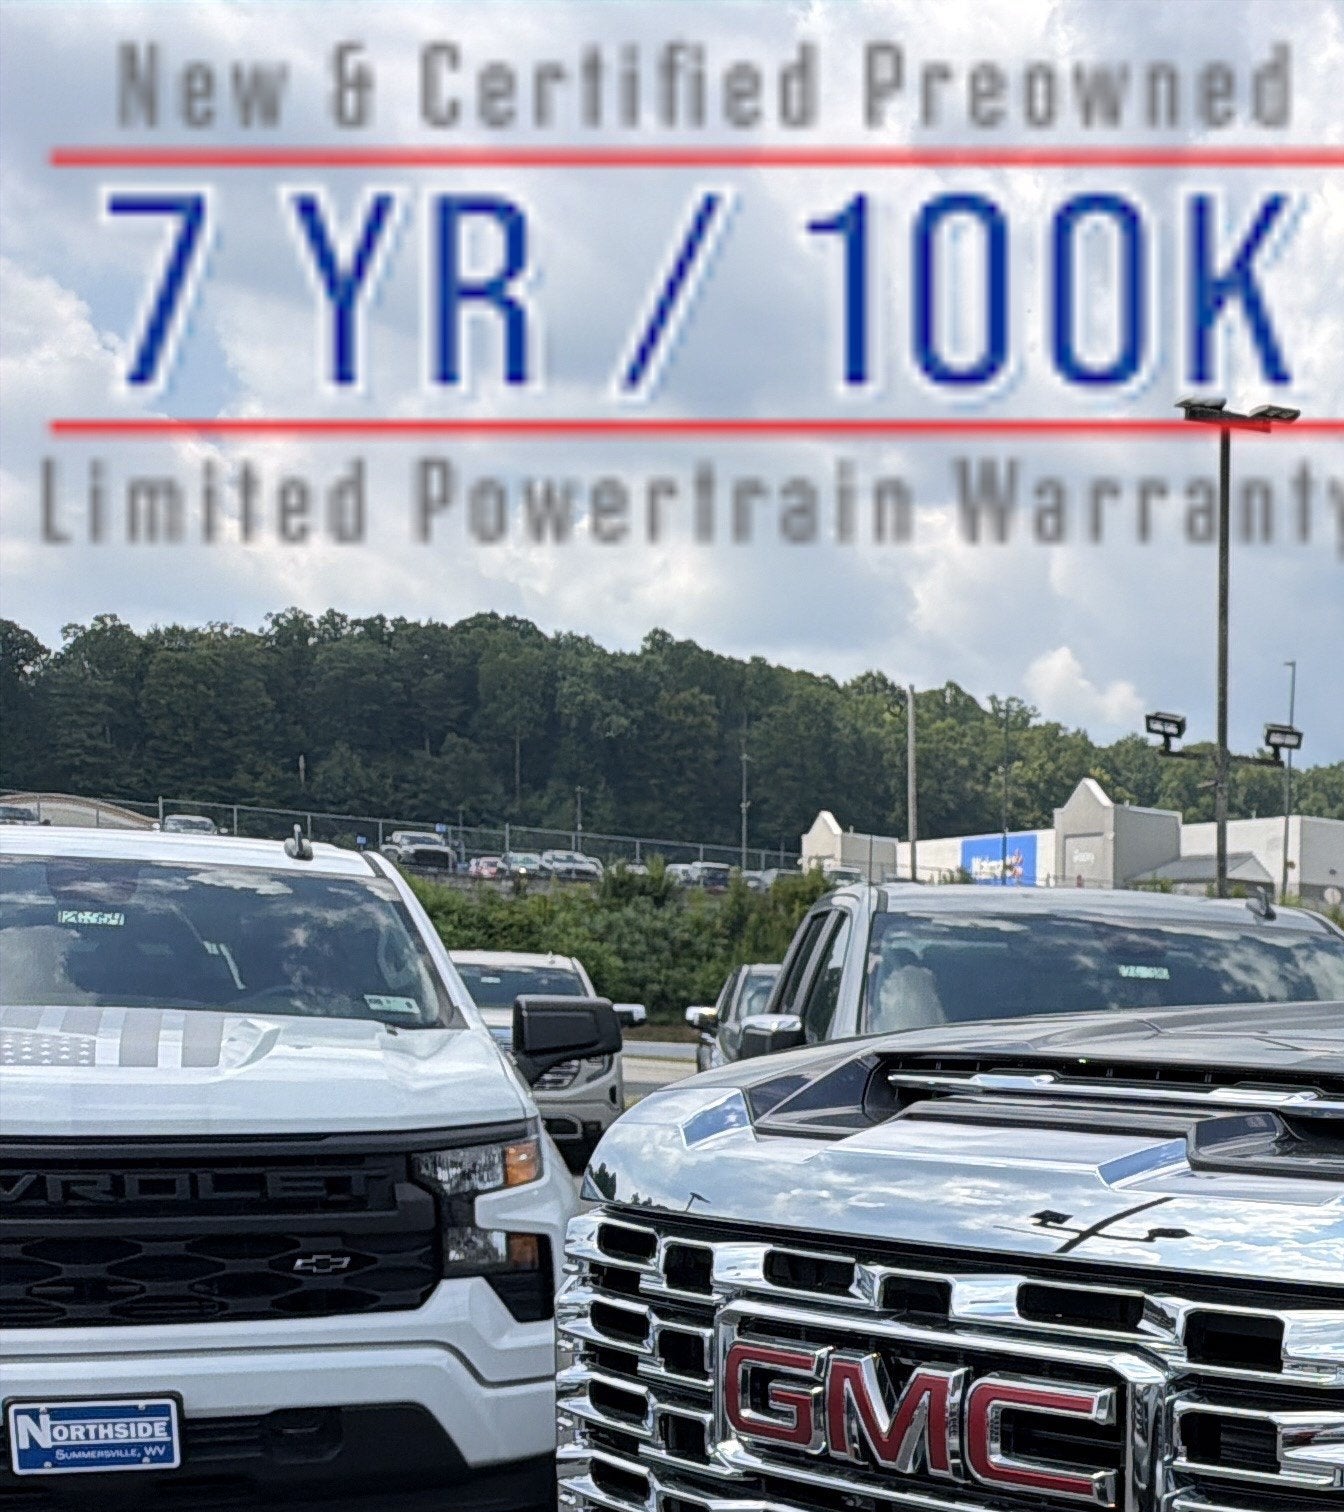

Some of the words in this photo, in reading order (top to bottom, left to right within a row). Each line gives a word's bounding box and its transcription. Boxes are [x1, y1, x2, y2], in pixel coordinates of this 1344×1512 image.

[16, 1412, 168, 1450] NORTHSIDE
[722, 1336, 1115, 1507] GMC
[143, 1445, 166, 1456] WV
